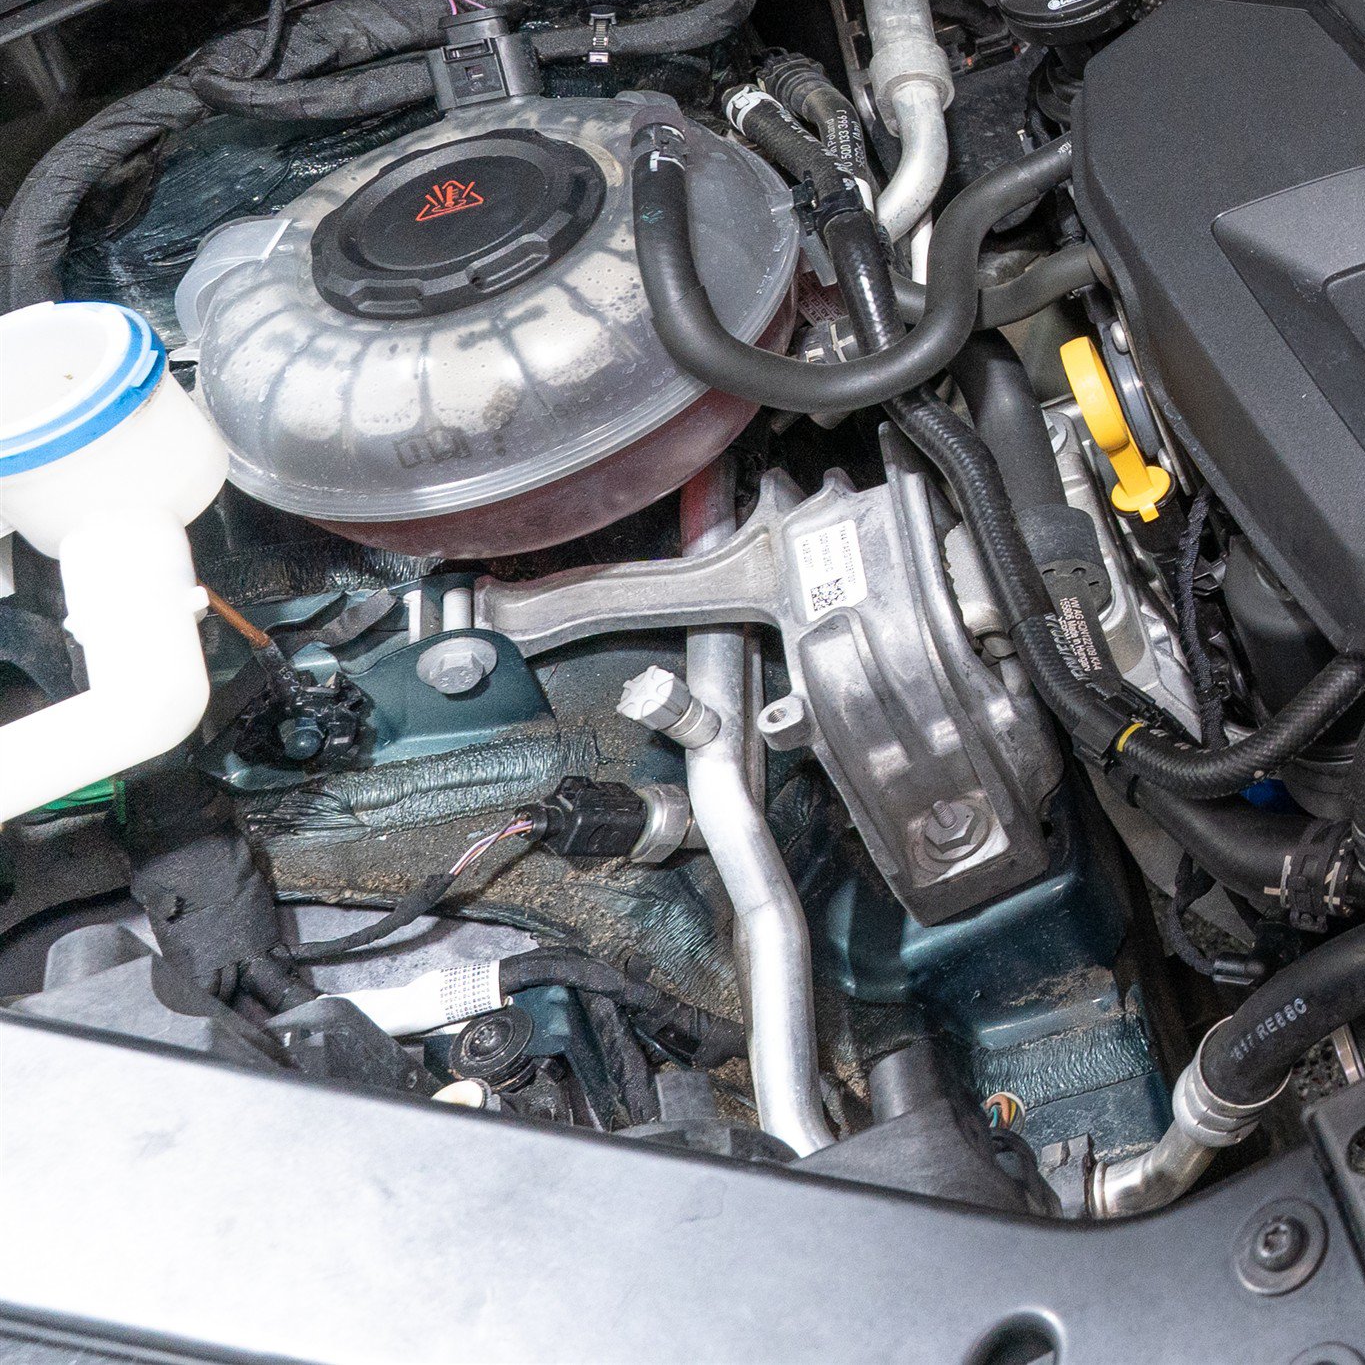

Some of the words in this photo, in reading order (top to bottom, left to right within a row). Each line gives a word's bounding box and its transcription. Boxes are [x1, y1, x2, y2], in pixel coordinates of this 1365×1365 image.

[836, 114, 848, 128] 366
[823, 118, 836, 147] Poland
[837, 130, 850, 143] 133
[1068, 595, 1081, 609] VW
[1072, 607, 1085, 620] AG
[1065, 618, 1080, 638] Made
[1074, 642, 1091, 672] Hungary
